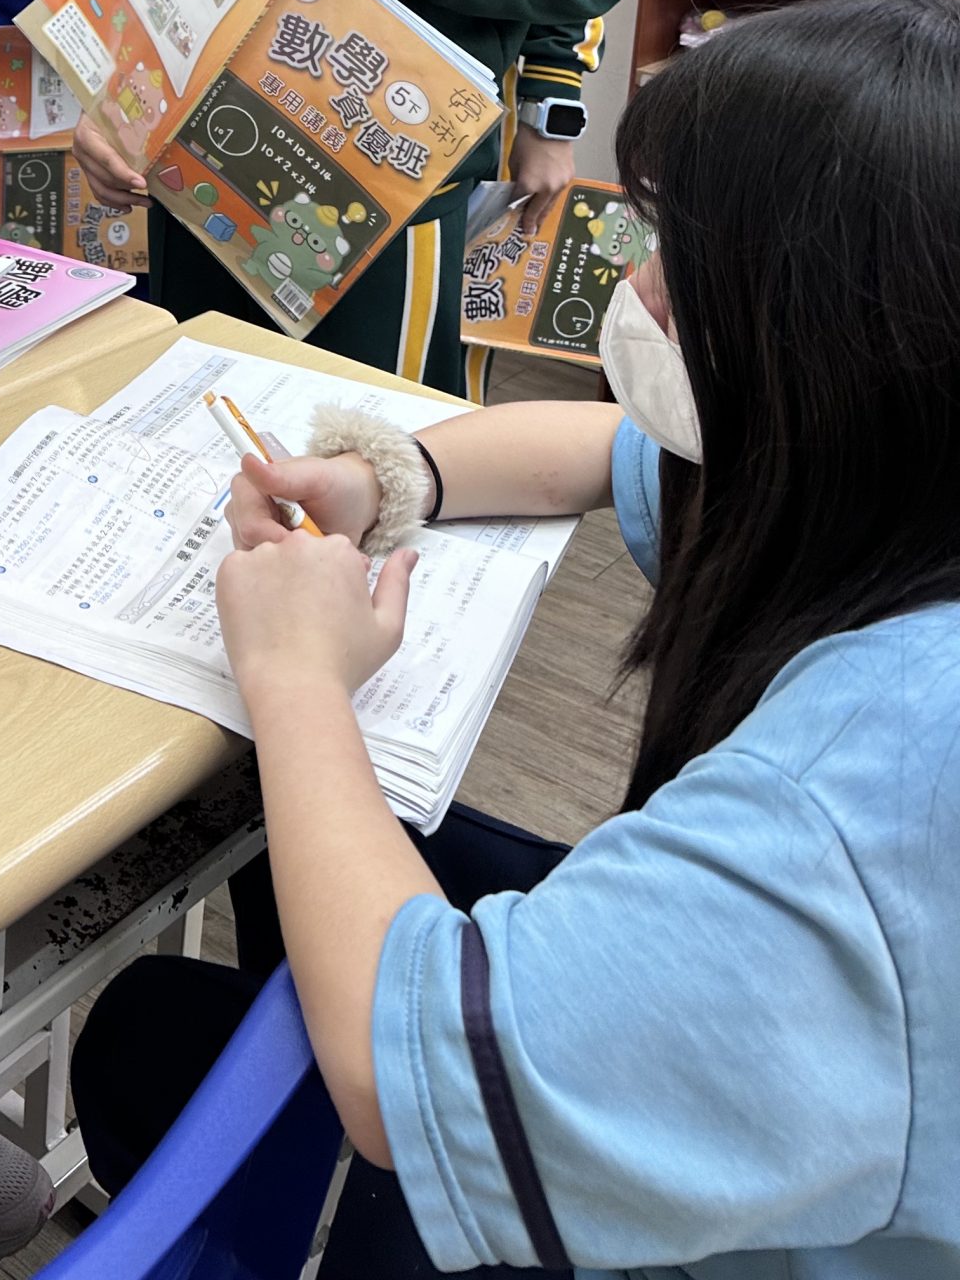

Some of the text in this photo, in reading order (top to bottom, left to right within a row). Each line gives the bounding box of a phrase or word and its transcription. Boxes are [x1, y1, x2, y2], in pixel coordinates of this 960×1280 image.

[258, 72, 348, 153] 專用講義
[390, 85, 422, 115] 5下
[176, 513, 218, 565] 學習挑戰
